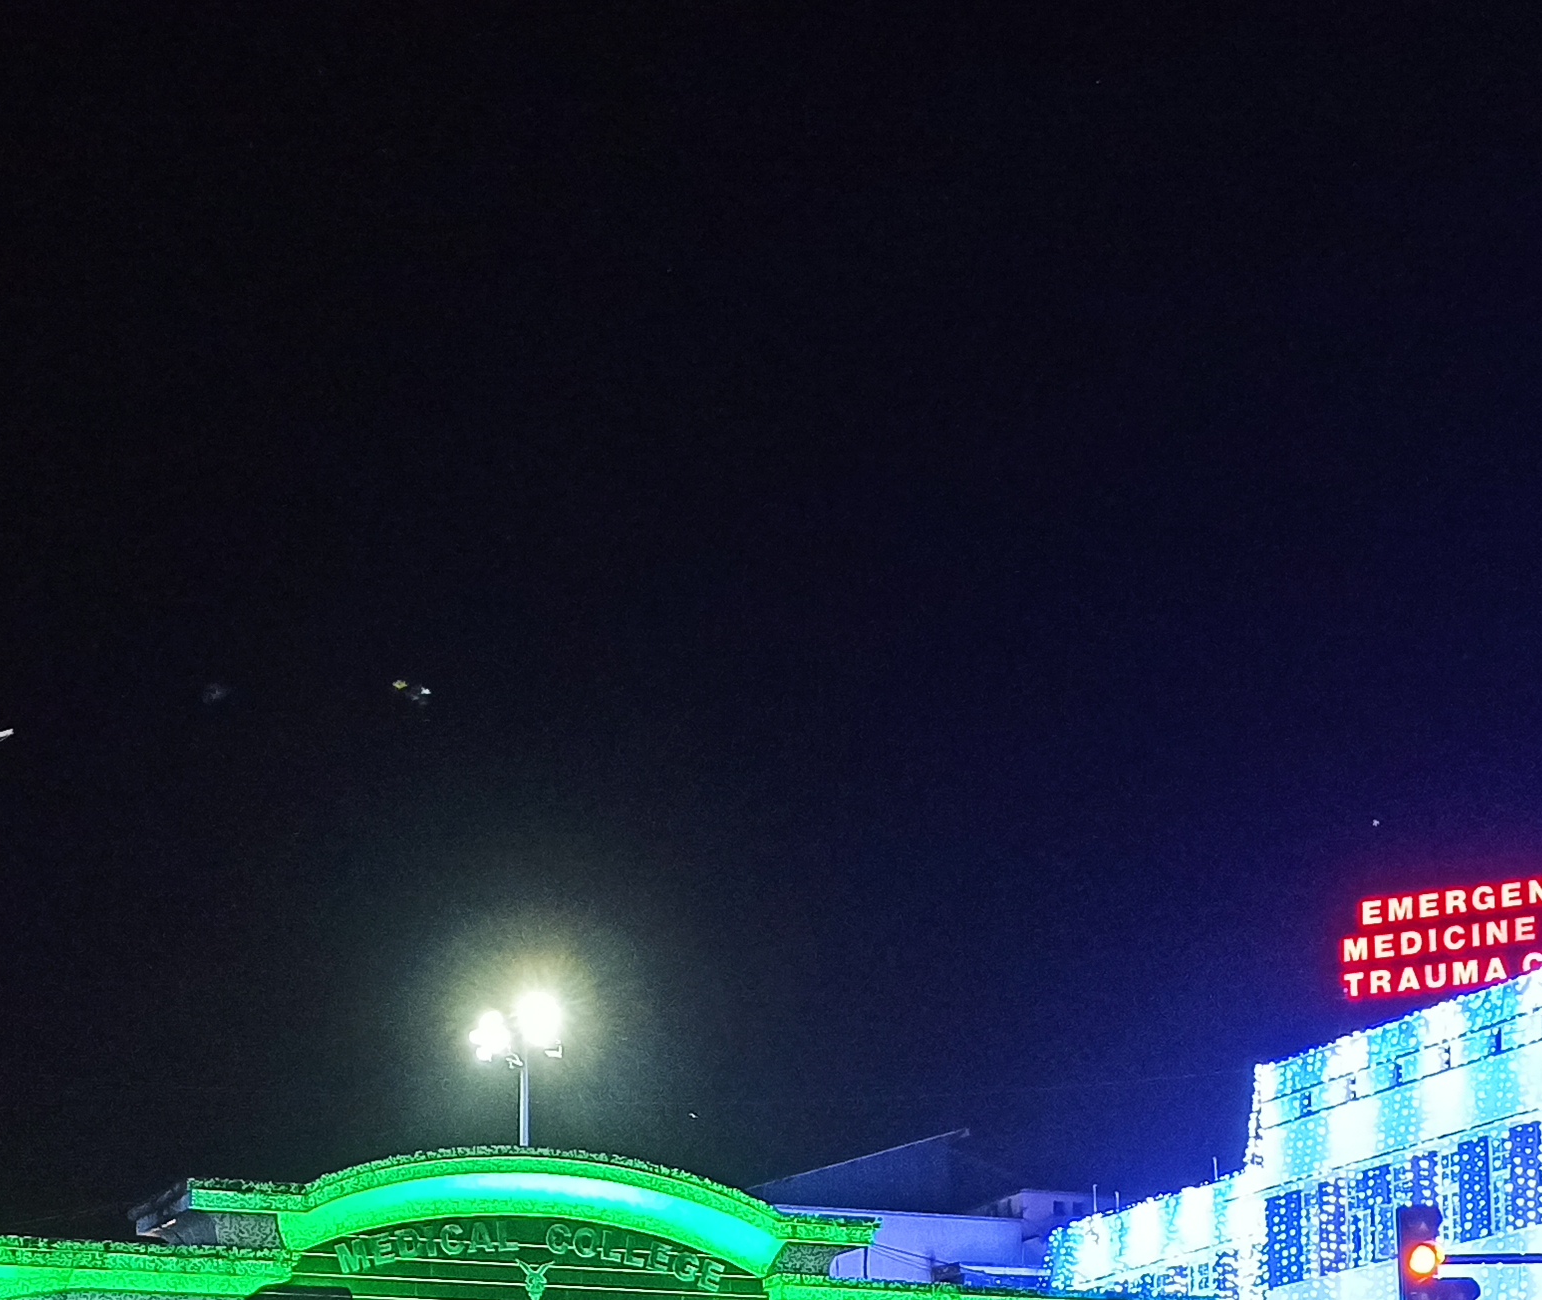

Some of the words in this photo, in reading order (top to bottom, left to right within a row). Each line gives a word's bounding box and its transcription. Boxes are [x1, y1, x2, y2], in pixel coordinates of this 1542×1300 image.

[1342, 916, 1536, 962] MEDICINE
[1343, 957, 1508, 997] TRAUMA
[334, 1221, 520, 1274] MEDICAL
[546, 1224, 726, 1292] COLLEGE
